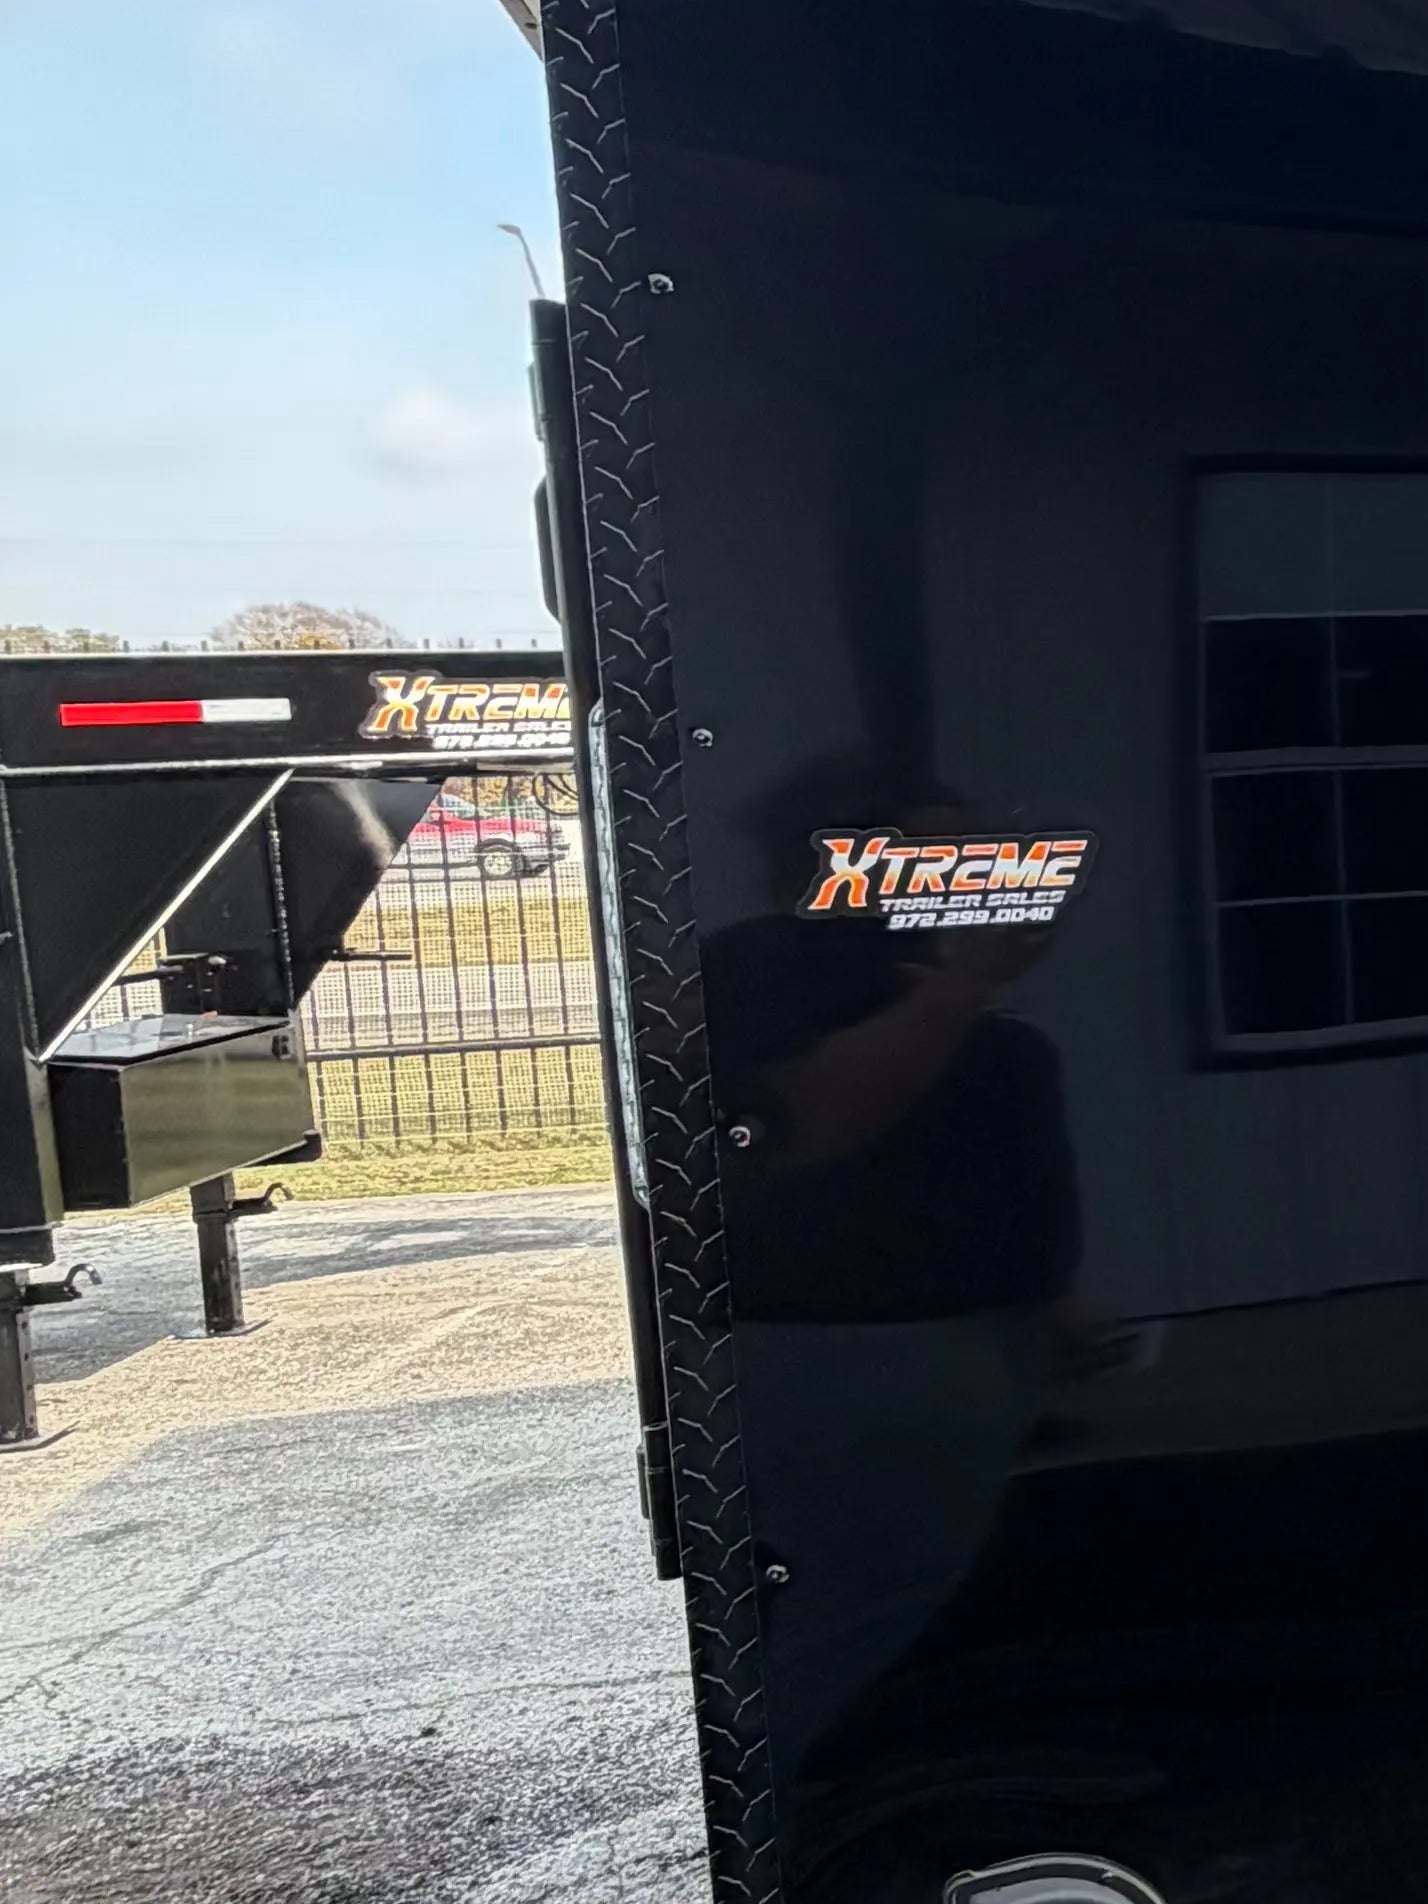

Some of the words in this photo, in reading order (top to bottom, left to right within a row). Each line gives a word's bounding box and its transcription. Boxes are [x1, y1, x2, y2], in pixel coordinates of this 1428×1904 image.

[808, 837, 1089, 910] XTREME
[879, 893, 982, 913] TRAILER
[985, 890, 1067, 907] SALES
[888, 906, 1055, 930] 972.299.0040
